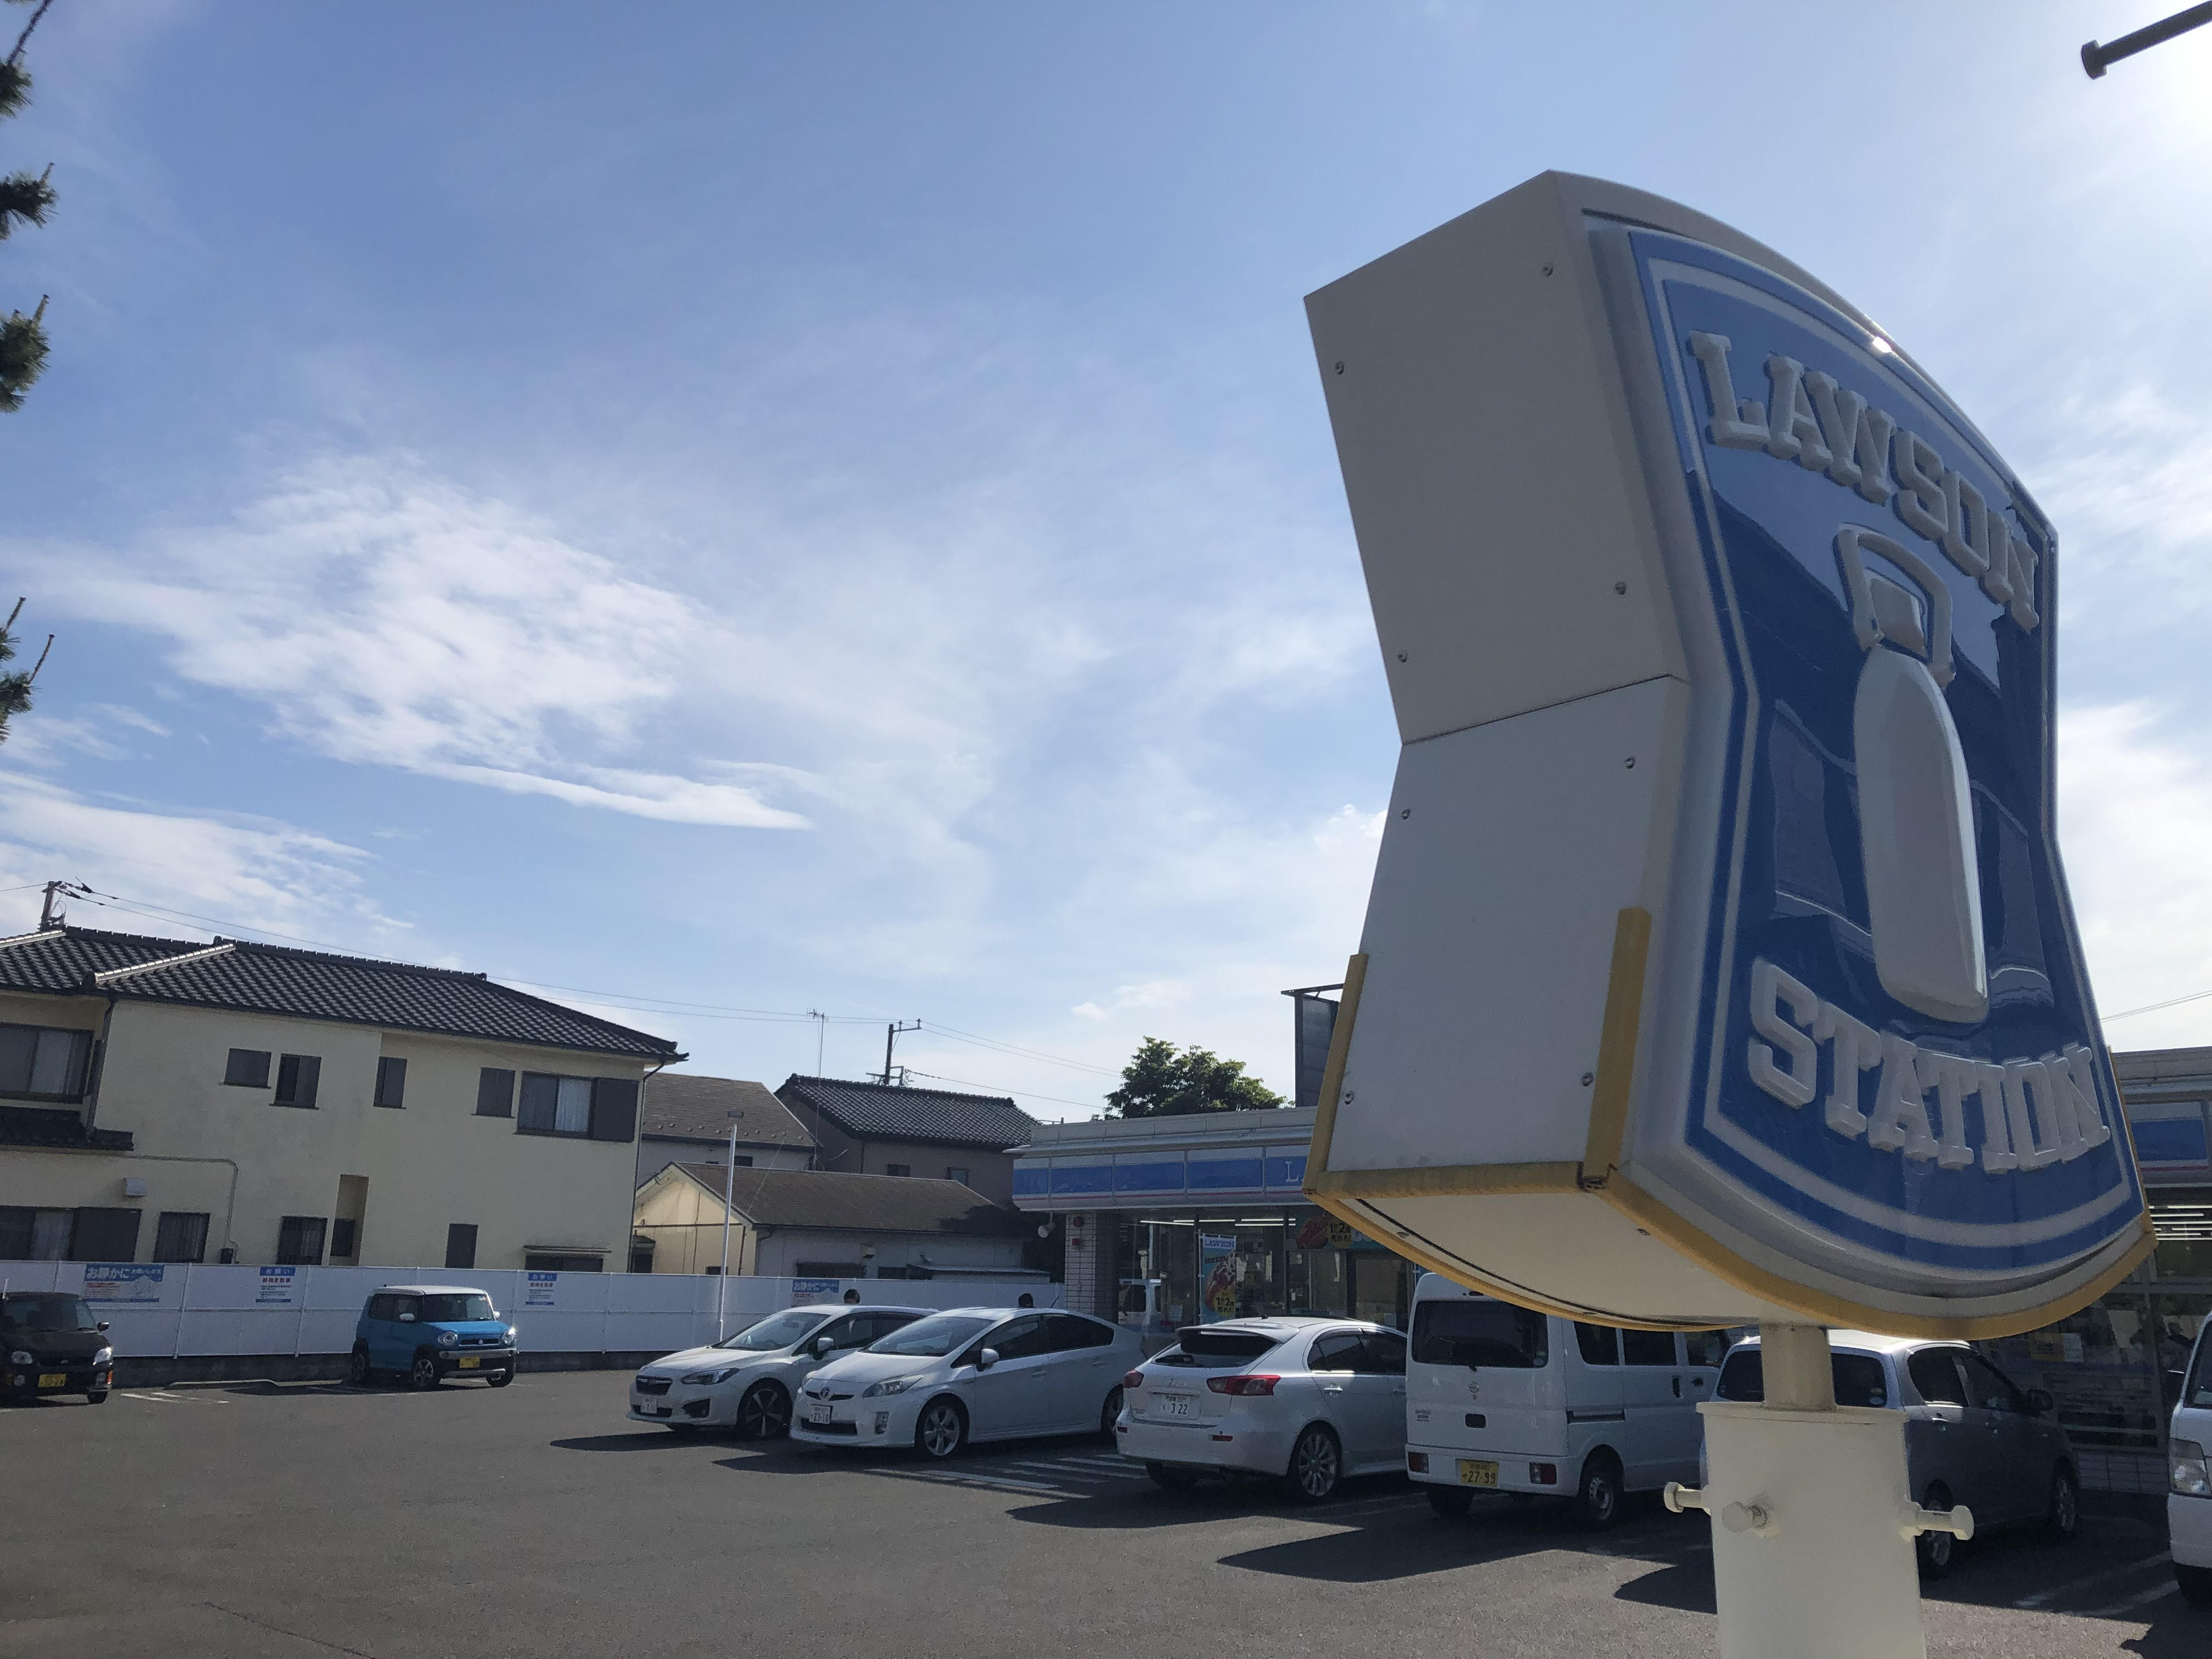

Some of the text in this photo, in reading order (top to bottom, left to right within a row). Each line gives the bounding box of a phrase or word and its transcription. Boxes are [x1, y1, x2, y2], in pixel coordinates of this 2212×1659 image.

[1686, 330, 2040, 634] LAWSON
[1748, 957, 2111, 1175] STATION
[1204, 1240, 1234, 1248] LAWSON
[1468, 1470, 1496, 1484] 27-99
